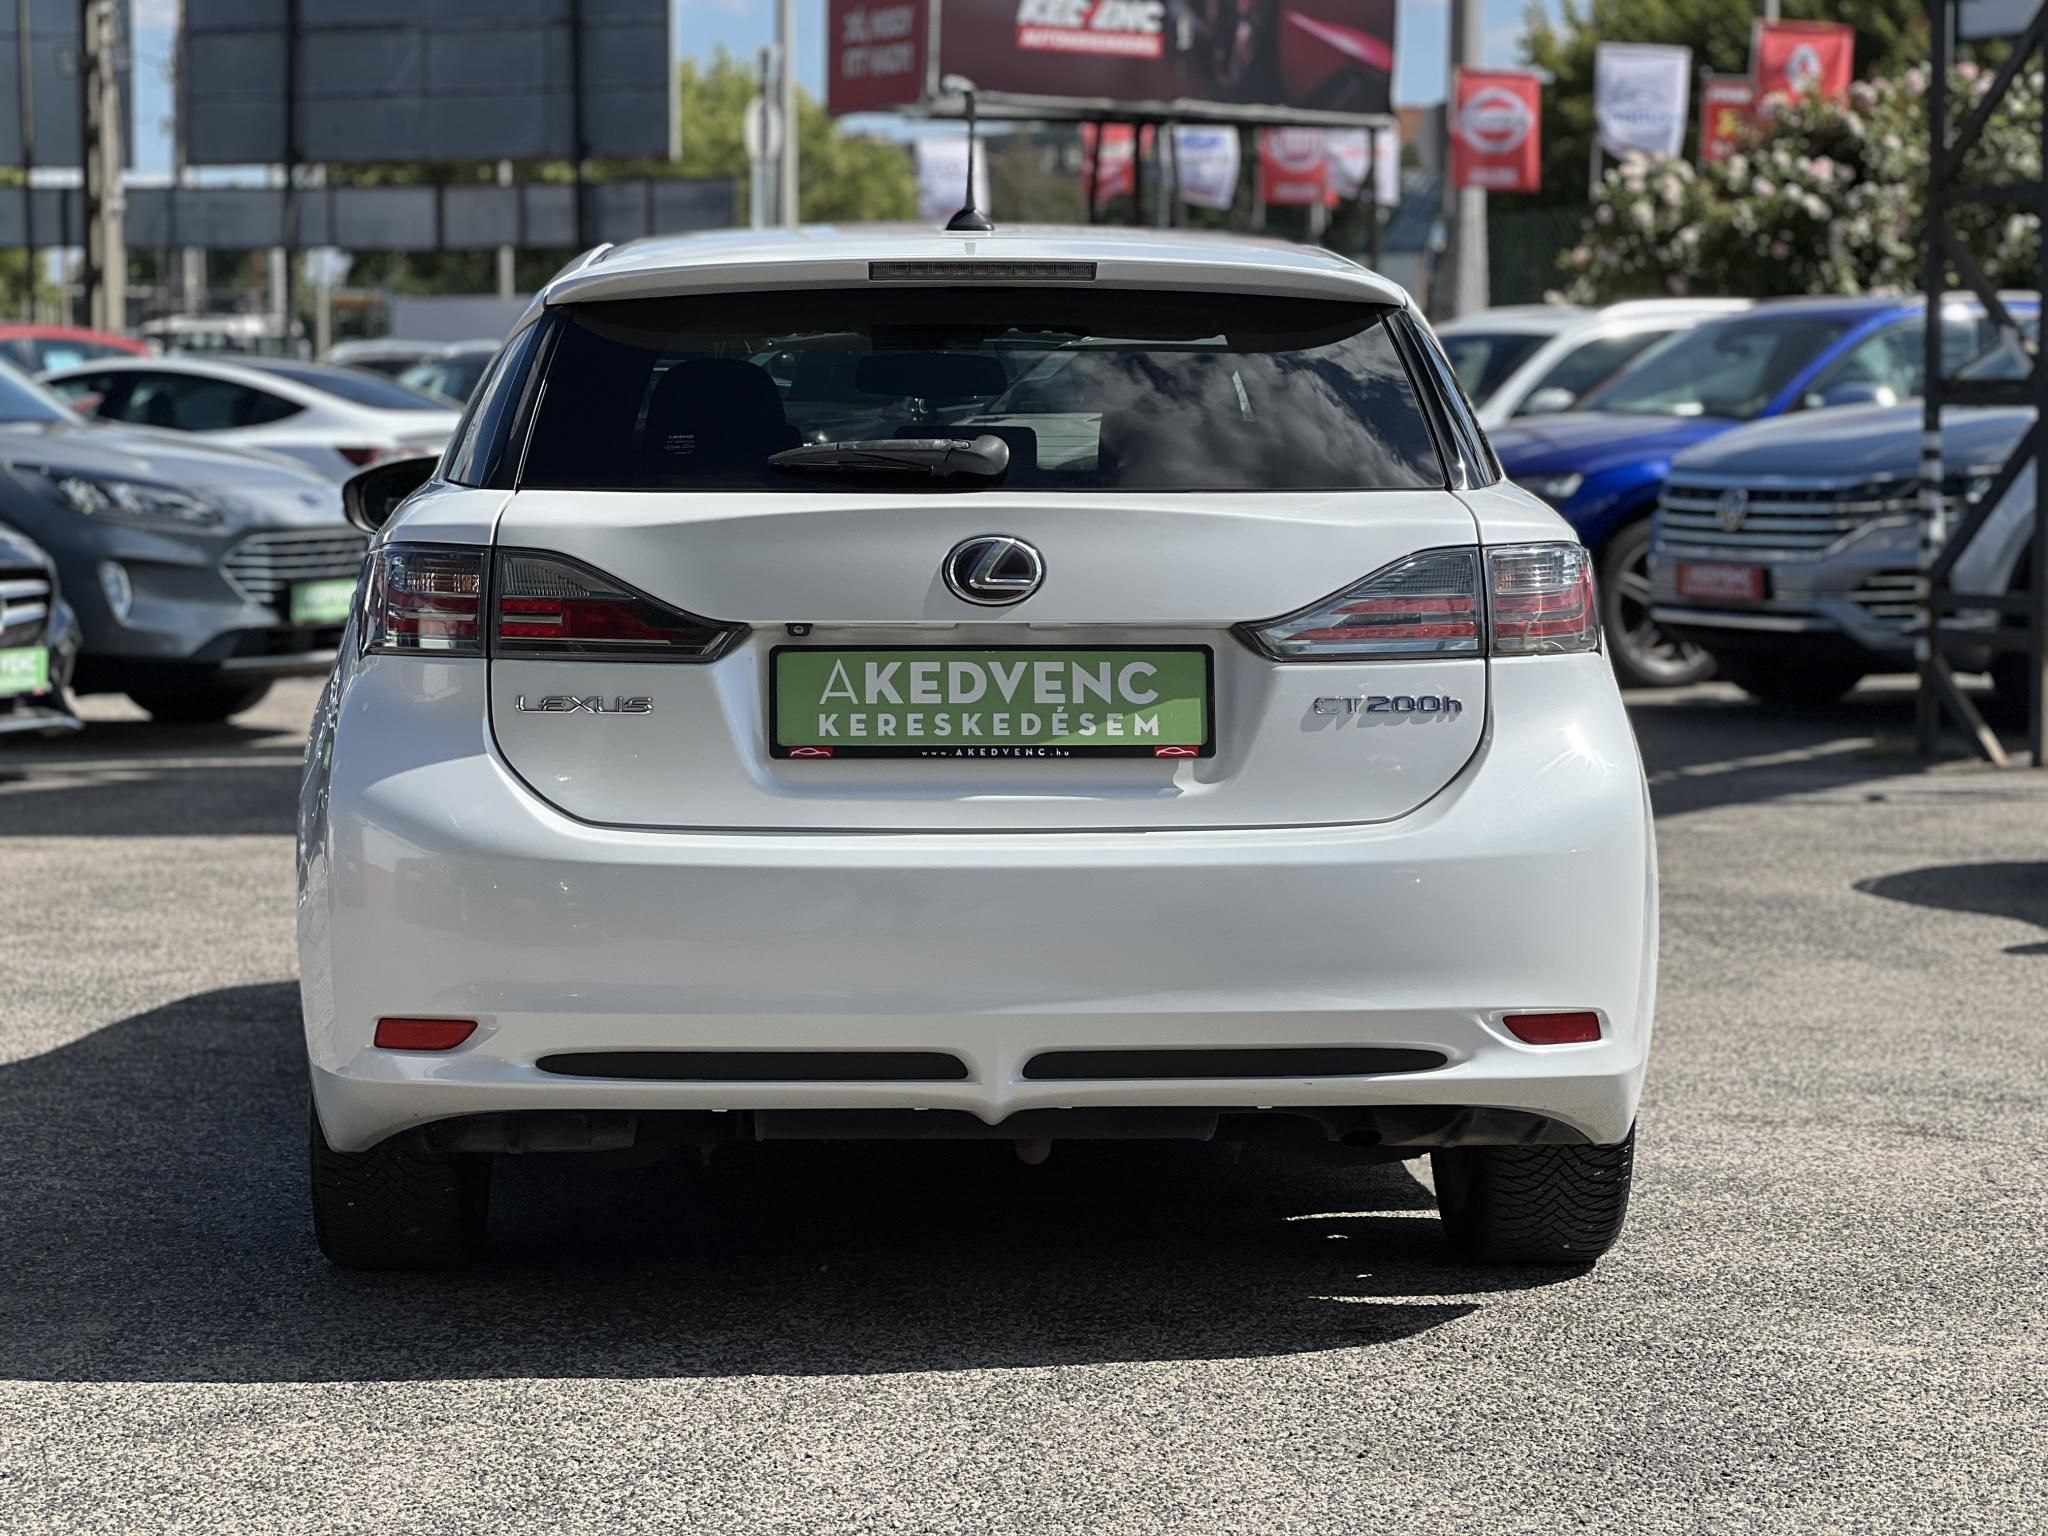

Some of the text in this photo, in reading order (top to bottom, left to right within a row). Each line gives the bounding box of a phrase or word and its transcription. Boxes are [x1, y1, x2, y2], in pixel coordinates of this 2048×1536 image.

[818, 657, 1159, 705] AKEDVENC
[515, 695, 653, 715] LEXUS
[818, 705, 1160, 737] KERESKEDÉSEM
[921, 748, 1070, 757] www.AKEDVENC.hu
